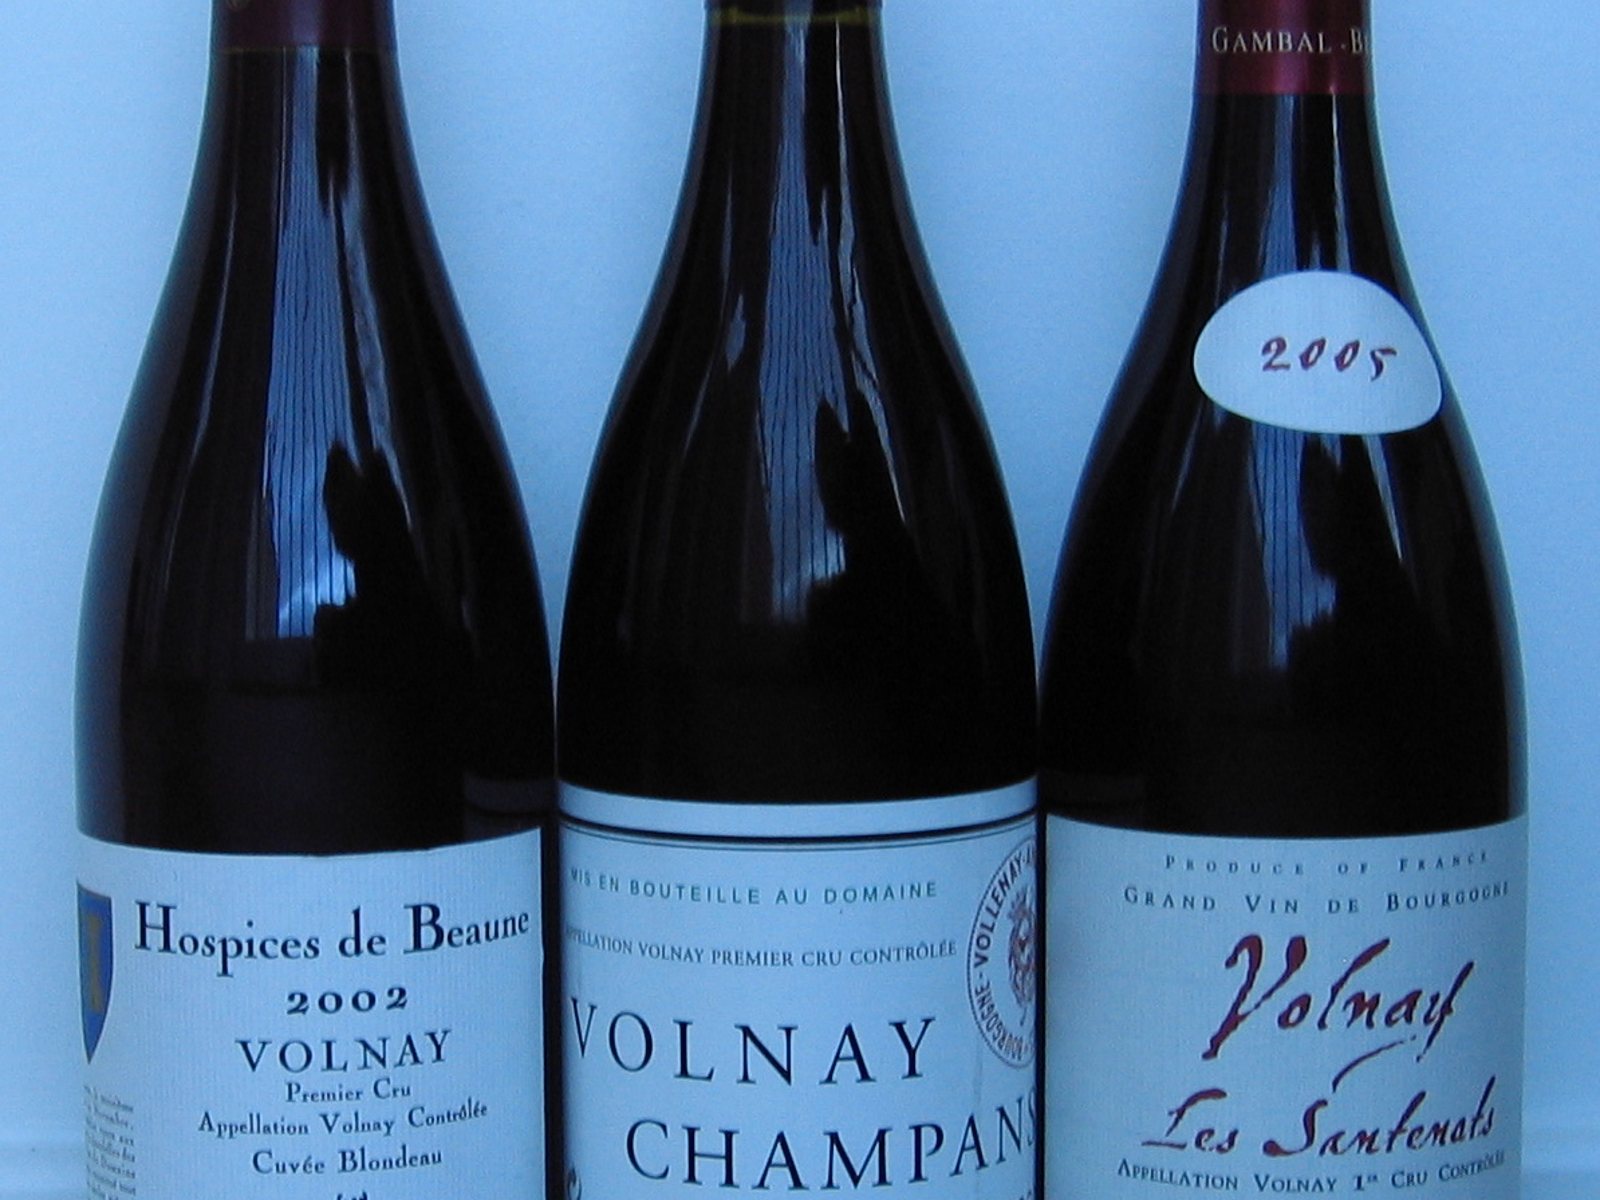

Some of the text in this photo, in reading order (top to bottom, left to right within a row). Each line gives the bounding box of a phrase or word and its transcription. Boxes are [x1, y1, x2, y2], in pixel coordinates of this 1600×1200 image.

[1212, 26, 1332, 54] GAMBAL
[1262, 336, 1396, 380] 2005
[1165, 850, 1487, 875] PRODUCE OF FRANCE
[599, 875, 620, 893] EN
[630, 879, 761, 905] BOUTEILLE
[775, 888, 808, 905] AU
[824, 880, 938, 904] DOMAINE
[1124, 880, 1508, 914] GRAND VIN DE BOURGOGNE
[134, 900, 530, 978] Hospices de Beaune
[638, 941, 704, 964] VOLNAY
[712, 949, 794, 967] PREMIER
[801, 950, 842, 967] CRU
[850, 938, 957, 965] CONTRÔLÉE
[286, 986, 408, 1016] 2002
[1202, 934, 1475, 1062] Volnay
[234, 1029, 452, 1073] VOLNAY
[570, 996, 937, 1087] VOLNAY
[286, 1078, 411, 1103] Premier Cru
[198, 1097, 489, 1140] Appellation Volnay Contrôlée
[1141, 1088, 1239, 1154] Les
[252, 1144, 443, 1176] Cuvée Blondeau
[1117, 1158, 1238, 1192] APPELLATION
[1253, 1173, 1337, 1193] VOLNAY
[1391, 1169, 1428, 1190] CRU
